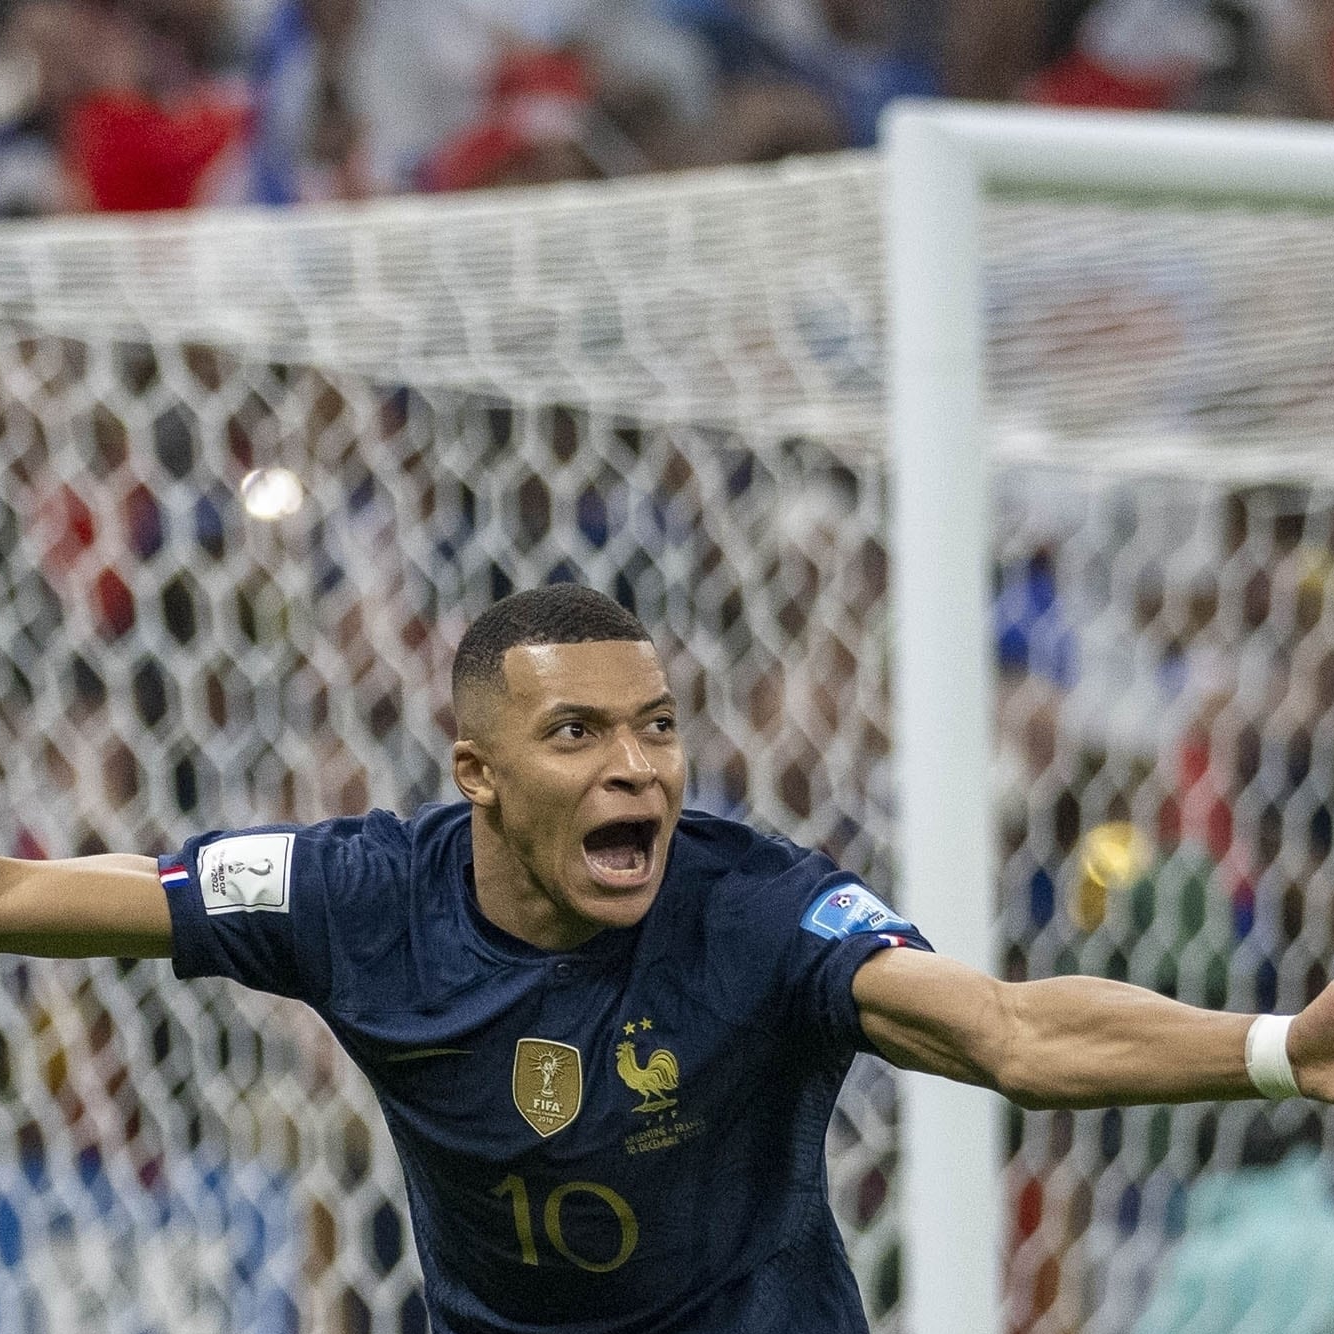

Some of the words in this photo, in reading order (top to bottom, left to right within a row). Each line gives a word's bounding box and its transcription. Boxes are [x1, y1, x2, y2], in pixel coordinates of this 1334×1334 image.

[871, 913, 885, 924] FIFA
[533, 1099, 560, 1112] FIFA
[490, 1173, 639, 1272] 10
